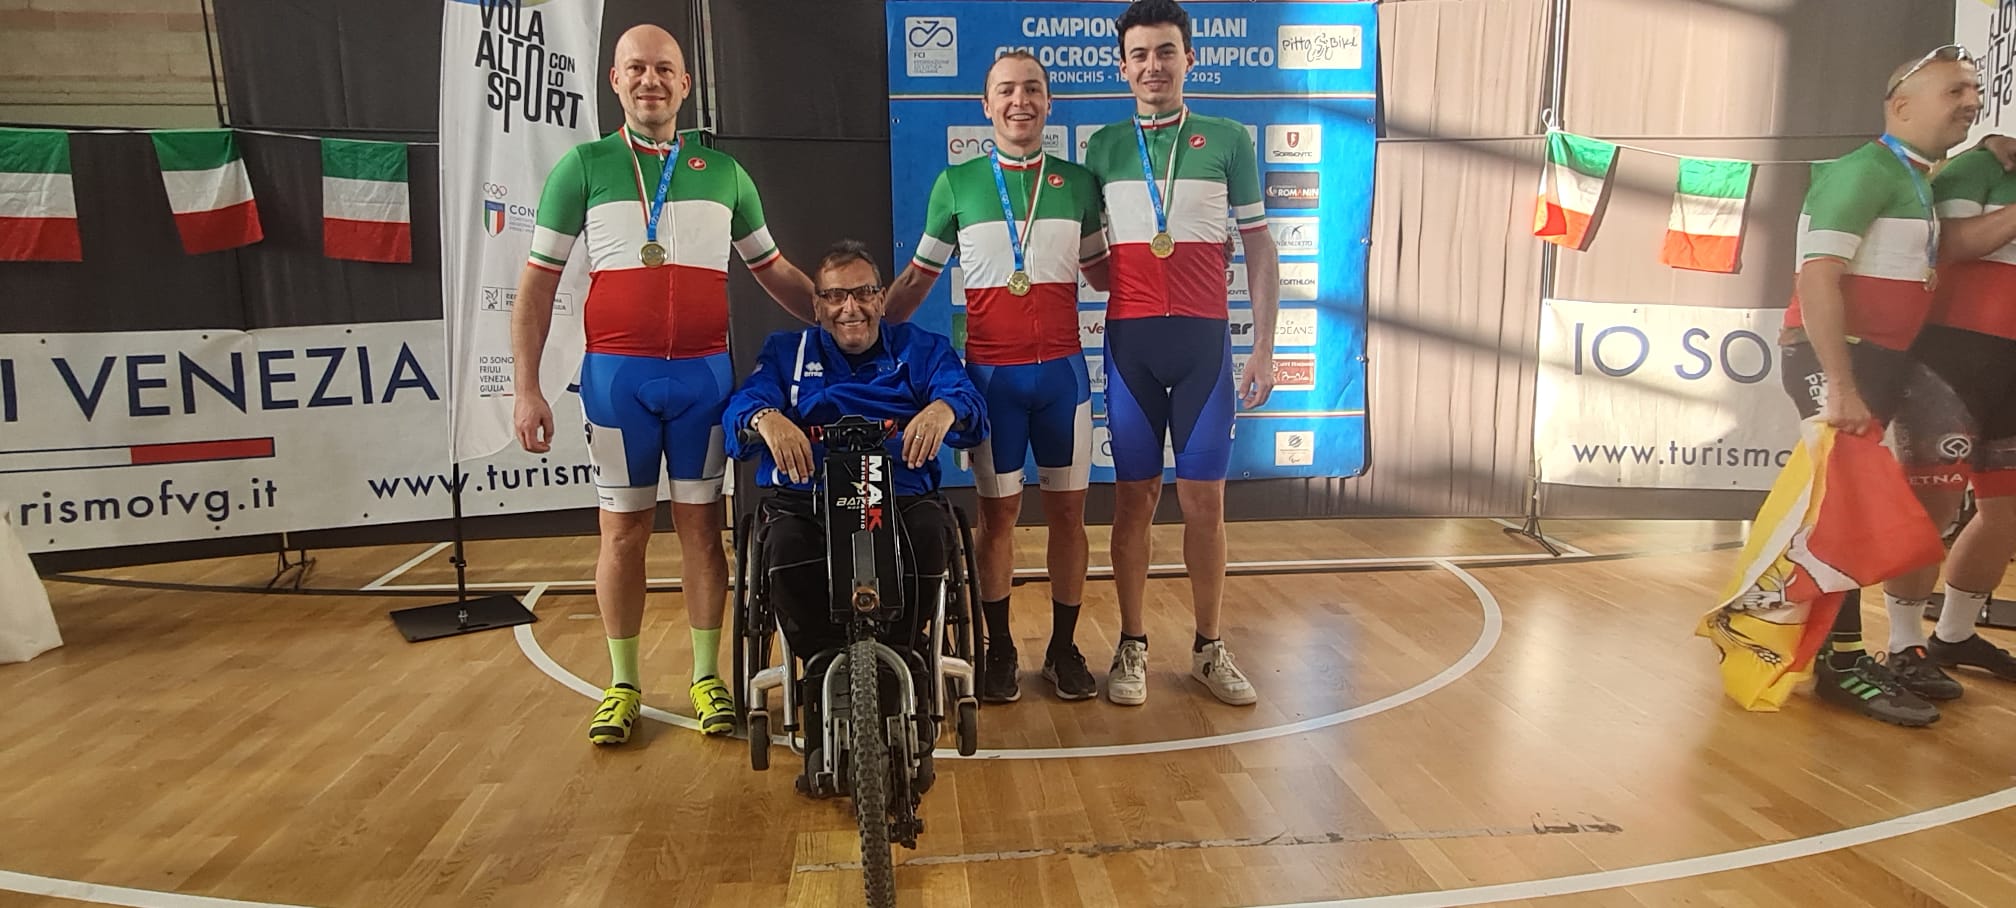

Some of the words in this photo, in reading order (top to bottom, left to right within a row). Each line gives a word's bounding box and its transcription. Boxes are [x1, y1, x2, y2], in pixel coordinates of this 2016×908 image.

[1022, 17, 1120, 38] CAMPION
[1191, 18, 1247, 37] LIANI
[549, 53, 575, 73] CON
[1195, 47, 1275, 67] IMPICO
[474, 30, 545, 122] ALTO
[548, 69, 564, 88] LO
[1191, 72, 1222, 85] 2025
[487, 44, 584, 133] SPORT
[1277, 188, 1319, 197] ROMANIN
[509, 204, 538, 219] CON
[479, 356, 488, 364] IO
[1573, 322, 1650, 377] IO
[1674, 327, 1773, 384] SO
[479, 366, 502, 374] FRIULI
[479, 375, 511, 383] VENEZIA
[51, 341, 441, 422] VENEZIA
[479, 385, 505, 393] GIULIA
[1911, 474, 1964, 485] ETNA
[20, 478, 278, 526] rismofvg.it
[868, 455, 883, 532] MAK
